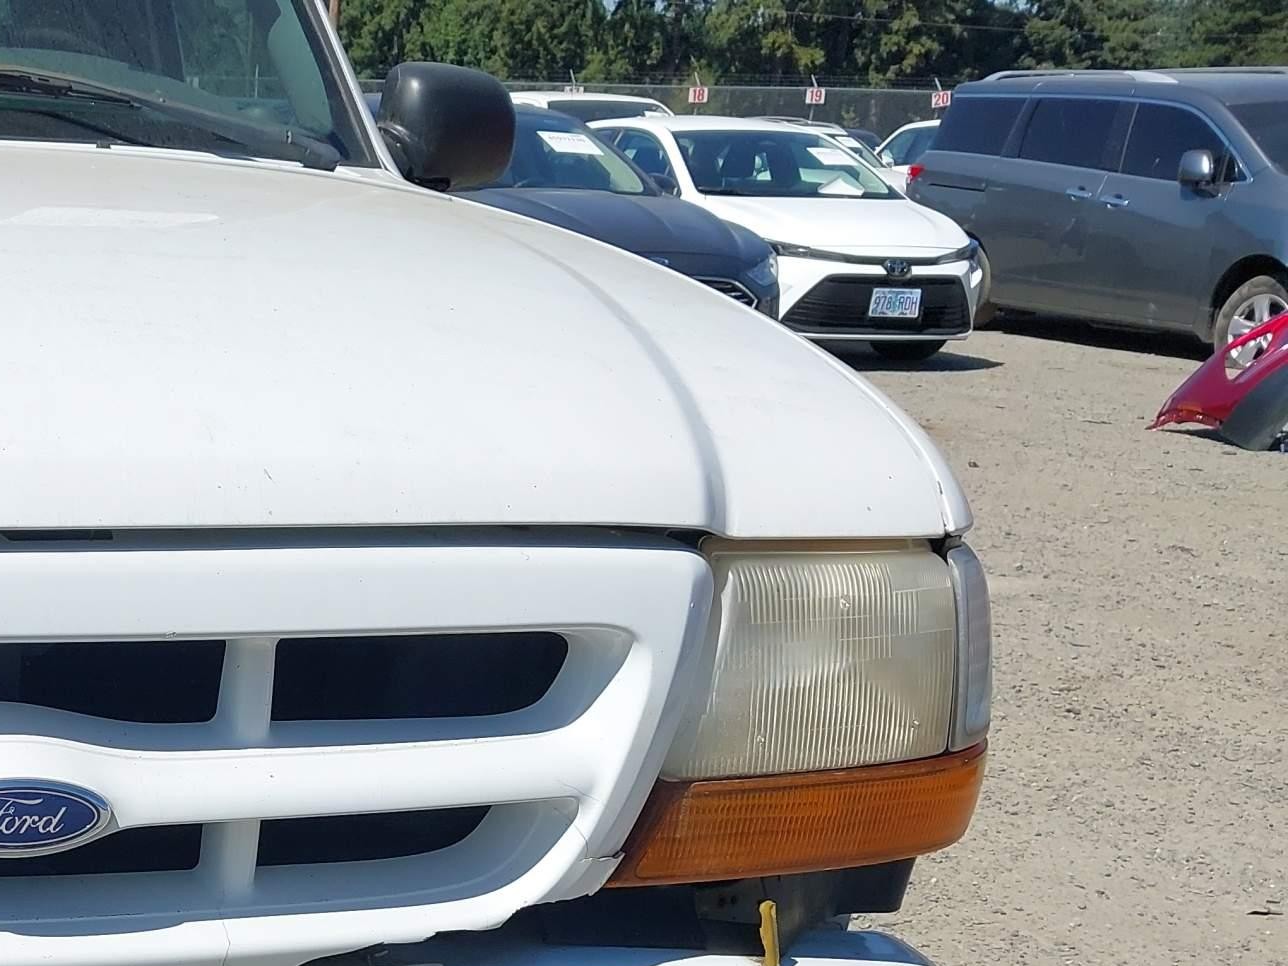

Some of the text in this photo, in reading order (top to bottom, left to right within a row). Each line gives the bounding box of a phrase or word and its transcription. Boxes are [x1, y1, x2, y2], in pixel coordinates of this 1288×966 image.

[692, 88, 705, 102] 18
[809, 89, 822, 102] 19
[933, 92, 949, 106] 20
